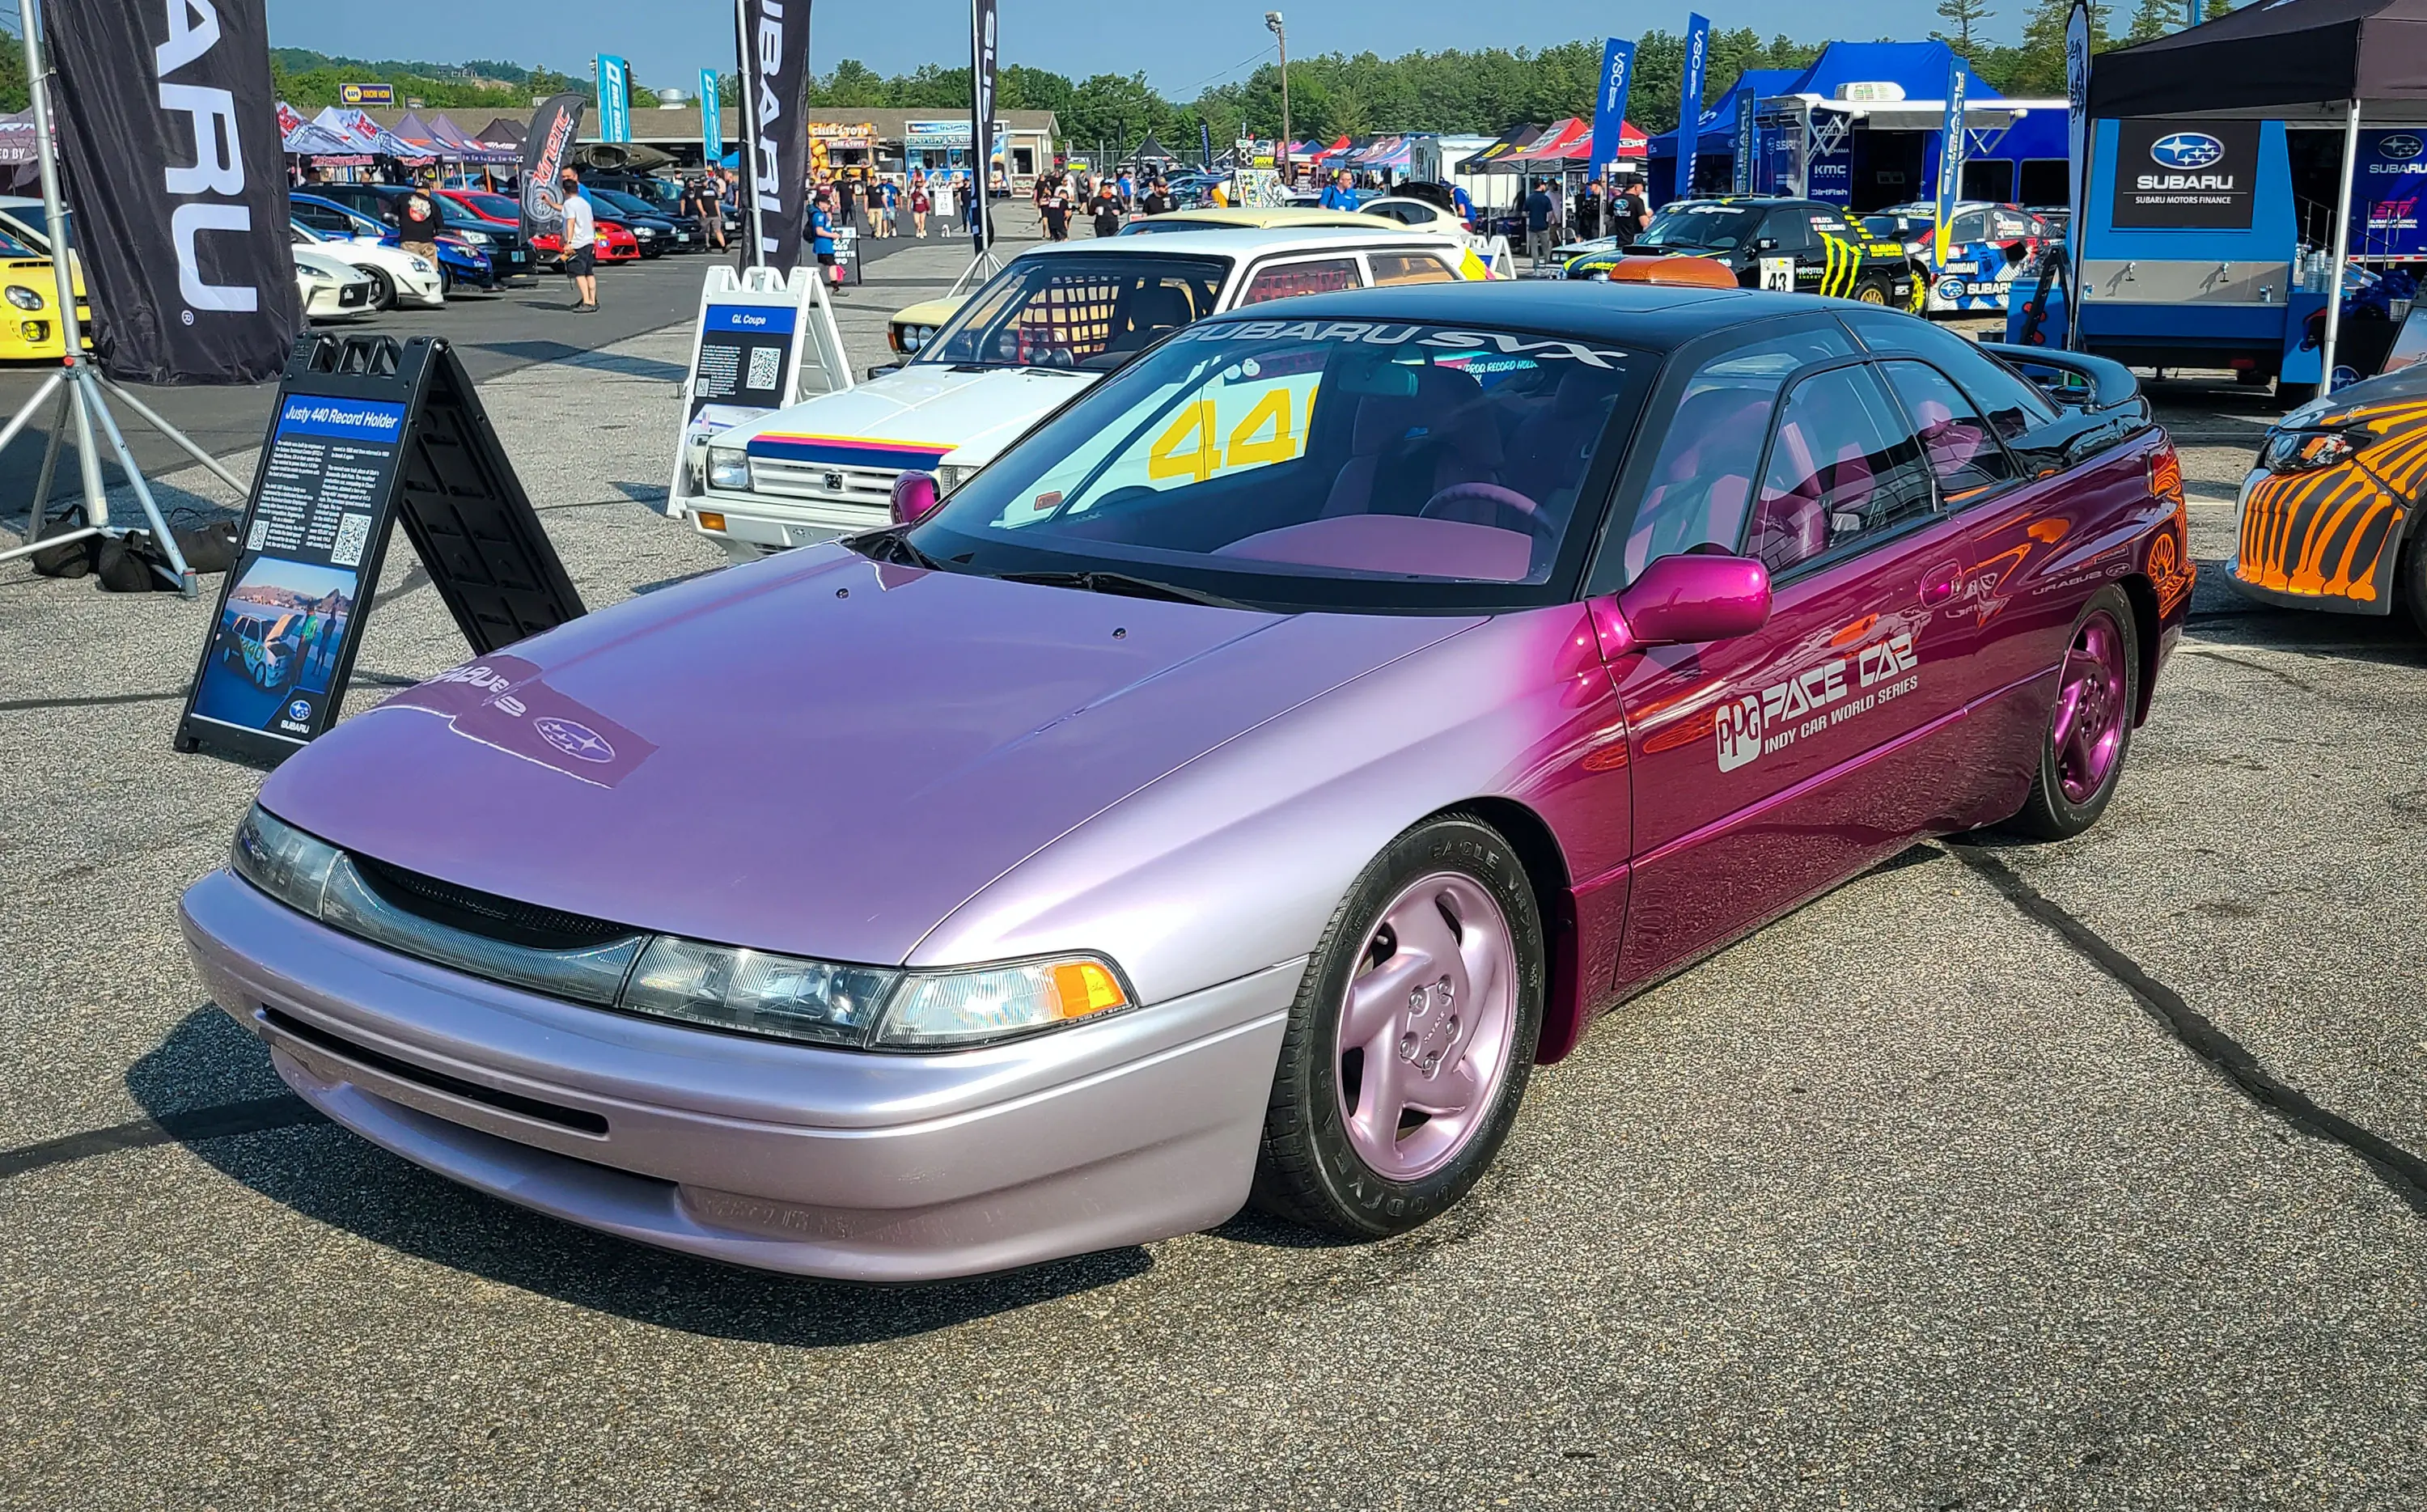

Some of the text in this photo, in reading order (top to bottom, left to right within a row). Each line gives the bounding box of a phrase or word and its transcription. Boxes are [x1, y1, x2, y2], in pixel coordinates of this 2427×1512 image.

[1610, 51, 1627, 87] VSC
[1942, 70, 1961, 195] SUBARU
[12, 147, 26, 160] BY
[1736, 98, 1749, 193] SUBARU
[1814, 164, 1847, 175] KMC
[2369, 163, 2427, 174] SUBARU
[2137, 175, 2234, 190] SUBARU
[2135, 196, 2232, 205] SUBARU MOTORS FINANCE
[1768, 272, 1787, 292] 43
[1967, 282, 2013, 295] SUBAR
[731, 314, 766, 326] GL Coupe
[1171, 322, 1629, 369] SUBARU SVX
[1486, 360, 1516, 373] RECORD
[286, 405, 398, 430] Justy 440 Record Holder
[1762, 659, 1848, 730] PACE
[1764, 675, 1918, 756] INDY CAR WORLD SERIES
[280, 719, 310, 734] SUBARU
[1717, 703, 1761, 759] PPG
[1429, 839, 1500, 870] EAGLE
